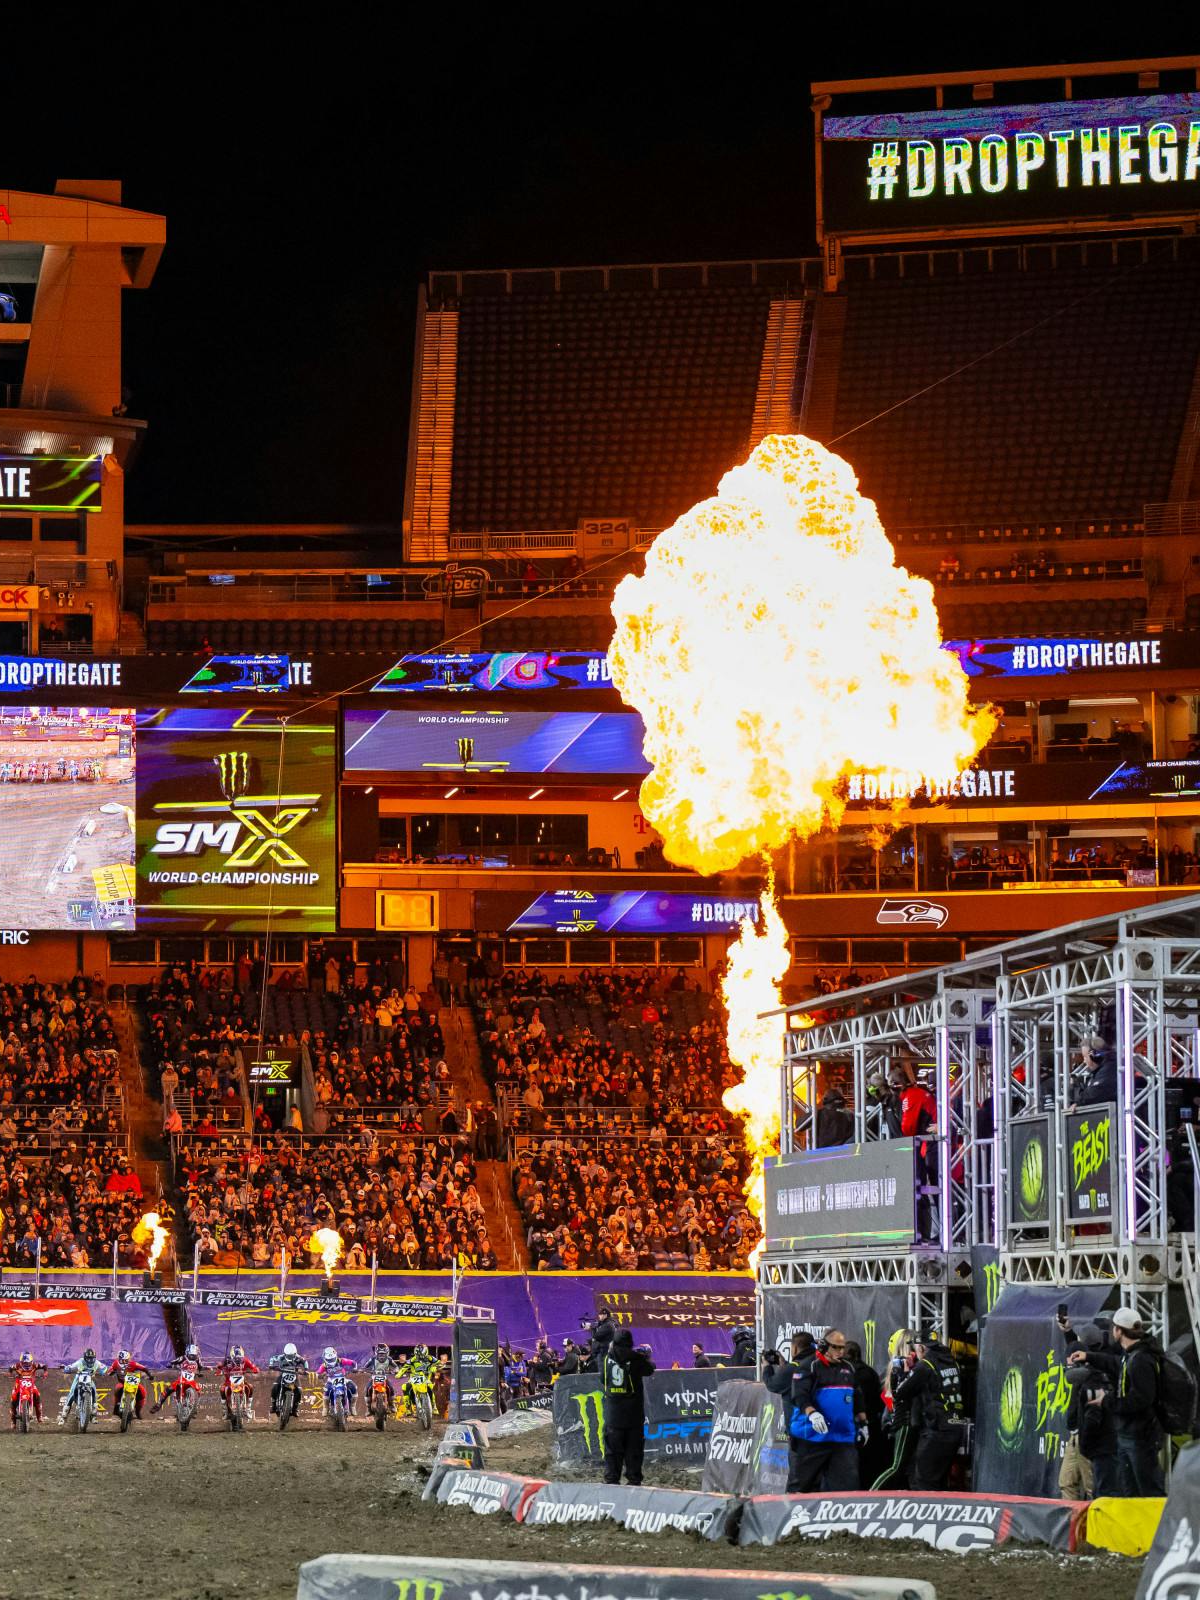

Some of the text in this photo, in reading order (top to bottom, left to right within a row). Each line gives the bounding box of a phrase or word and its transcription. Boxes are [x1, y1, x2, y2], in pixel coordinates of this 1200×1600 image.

[585, 523, 628, 535] 324
[1012, 640, 1161, 669] #DROPTHEGATE
[418, 715, 509, 725] WORLD CHAMPIONSHIP
[151, 808, 311, 867] SMX
[149, 871, 319, 885] WORLD CHAMPIONSHIP
[249, 1065, 289, 1079] SMX
[1073, 1116, 1110, 1192] BEAST
[461, 1352, 493, 1365] SMX
[612, 1364, 625, 1386] 9
[461, 1391, 494, 1403] SMX
[681, 1408, 713, 1416] ENE
[536, 1501, 600, 1524] TRIUMPH
[814, 1499, 1000, 1524] ROCKY MOUNTAIN
[625, 1508, 697, 1534] TRIUMPH
